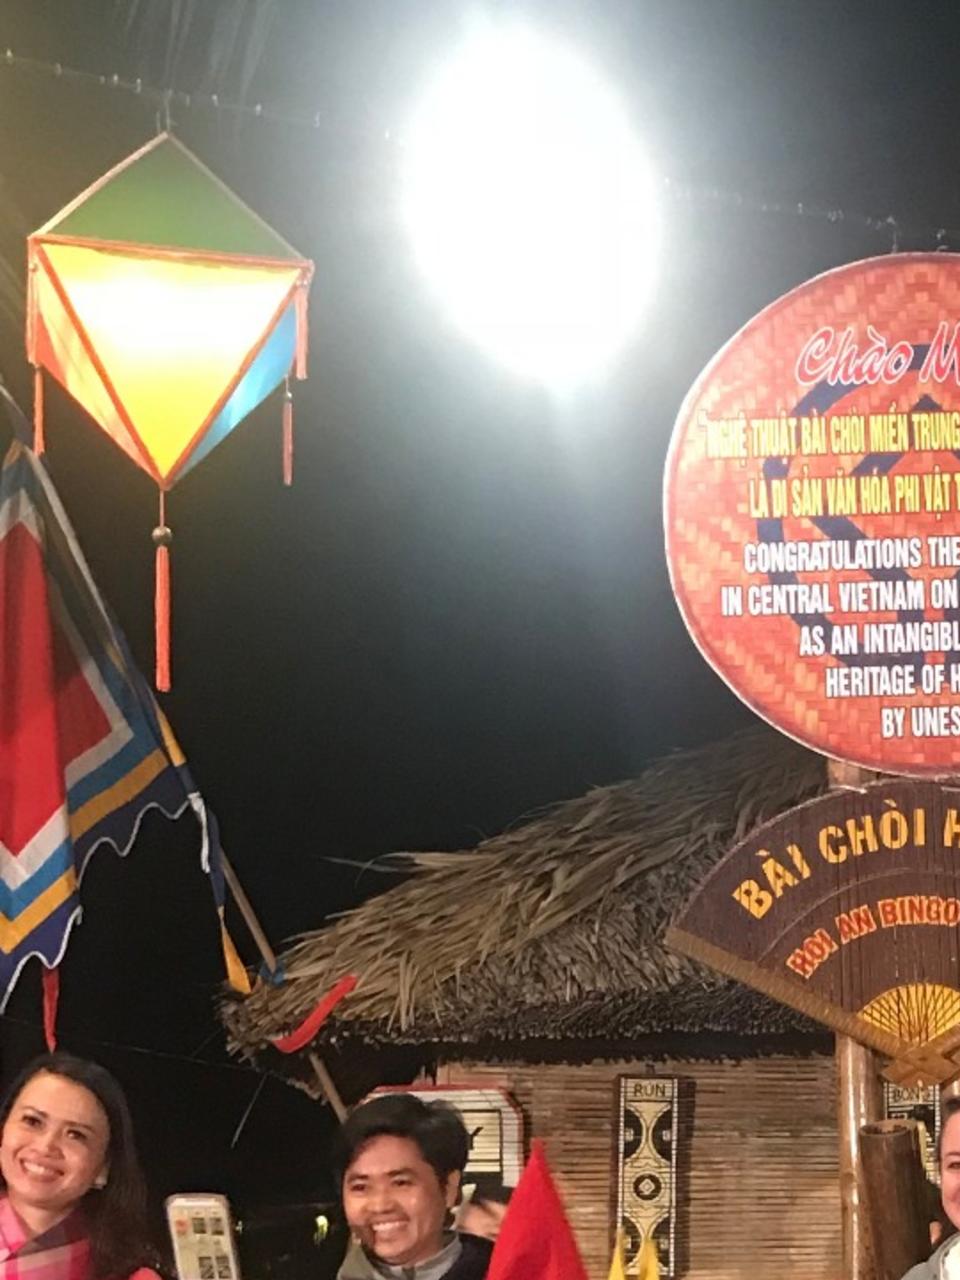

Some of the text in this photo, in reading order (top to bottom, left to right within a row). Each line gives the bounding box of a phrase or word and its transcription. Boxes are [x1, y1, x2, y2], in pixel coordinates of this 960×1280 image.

[795, 325, 914, 385] Chào
[750, 407, 797, 465] THUẬT
[801, 407, 826, 455] BÀI
[830, 405, 865, 455] CHÒI
[772, 479, 788, 516] DI
[792, 464, 823, 516] SẢN
[826, 467, 858, 516] VĂN
[861, 467, 891, 515] HÓA
[894, 474, 920, 512] PHI
[924, 464, 952, 520] VẬT
[743, 538, 922, 573] CONGRATULATIONS
[722, 586, 743, 616] IN
[748, 583, 834, 615] CENTRAL
[838, 580, 925, 612] VIETNAM
[931, 578, 959, 609] ON
[799, 626, 825, 656] AS
[831, 624, 858, 655] AN
[825, 664, 916, 698] HERITAGE
[921, 664, 945, 695] OF
[881, 706, 905, 738] BY
[731, 843, 812, 919] BÀI
[818, 800, 926, 864] CHÒI
[834, 904, 878, 945] AN
